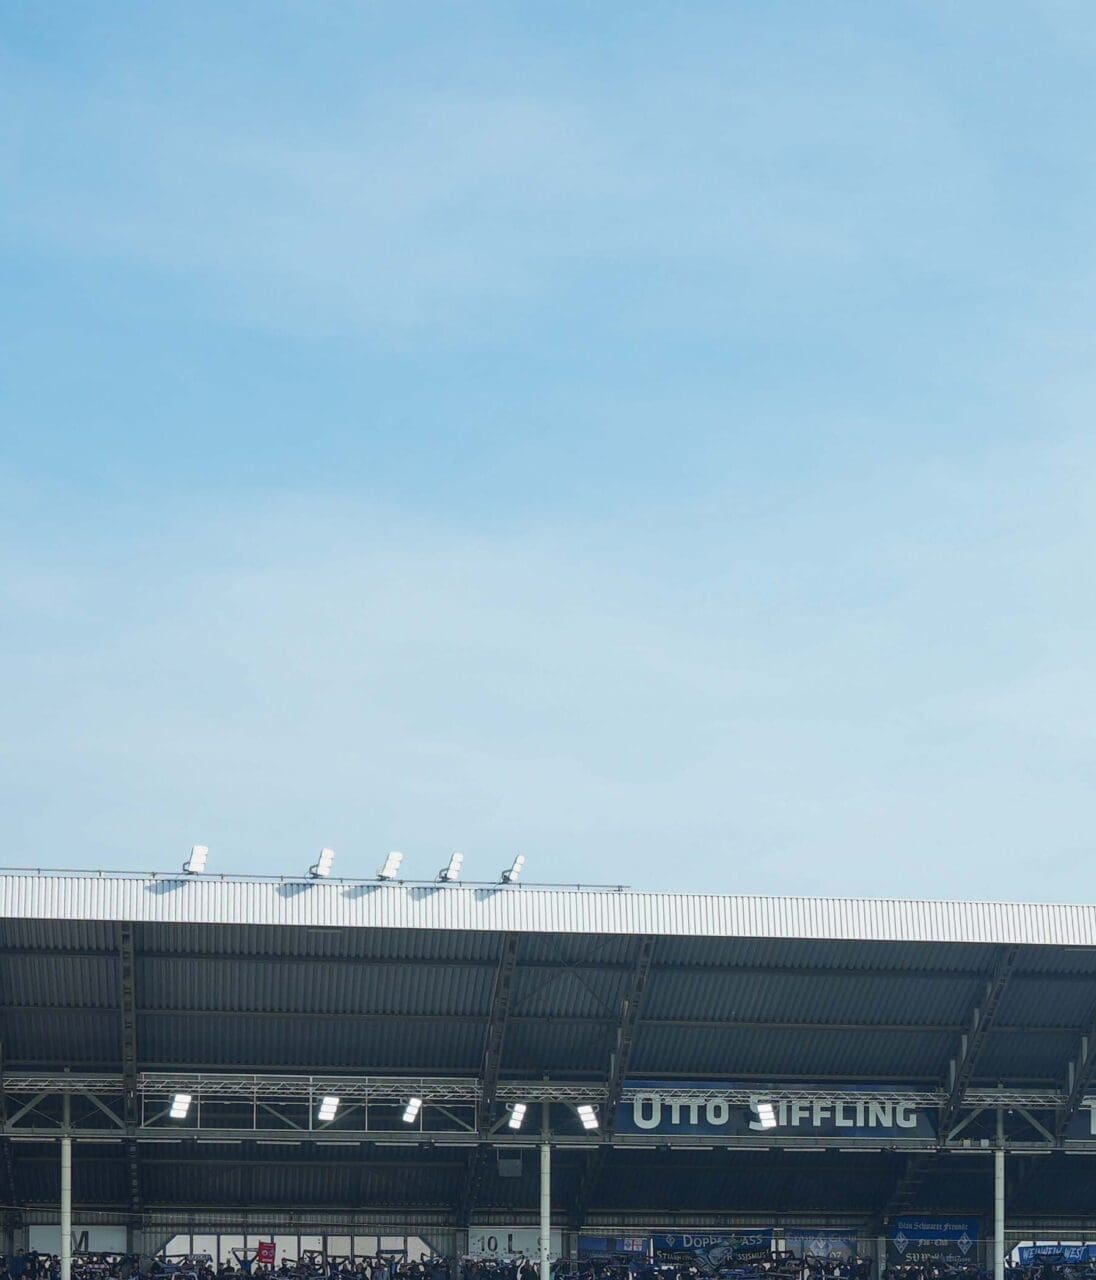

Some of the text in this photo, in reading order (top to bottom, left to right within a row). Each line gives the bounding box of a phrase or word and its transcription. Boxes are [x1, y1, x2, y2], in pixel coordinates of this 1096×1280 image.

[71, 1231, 89, 1252] M
[478, 1236, 498, 1251] 10
[508, 1234, 523, 1254] L
